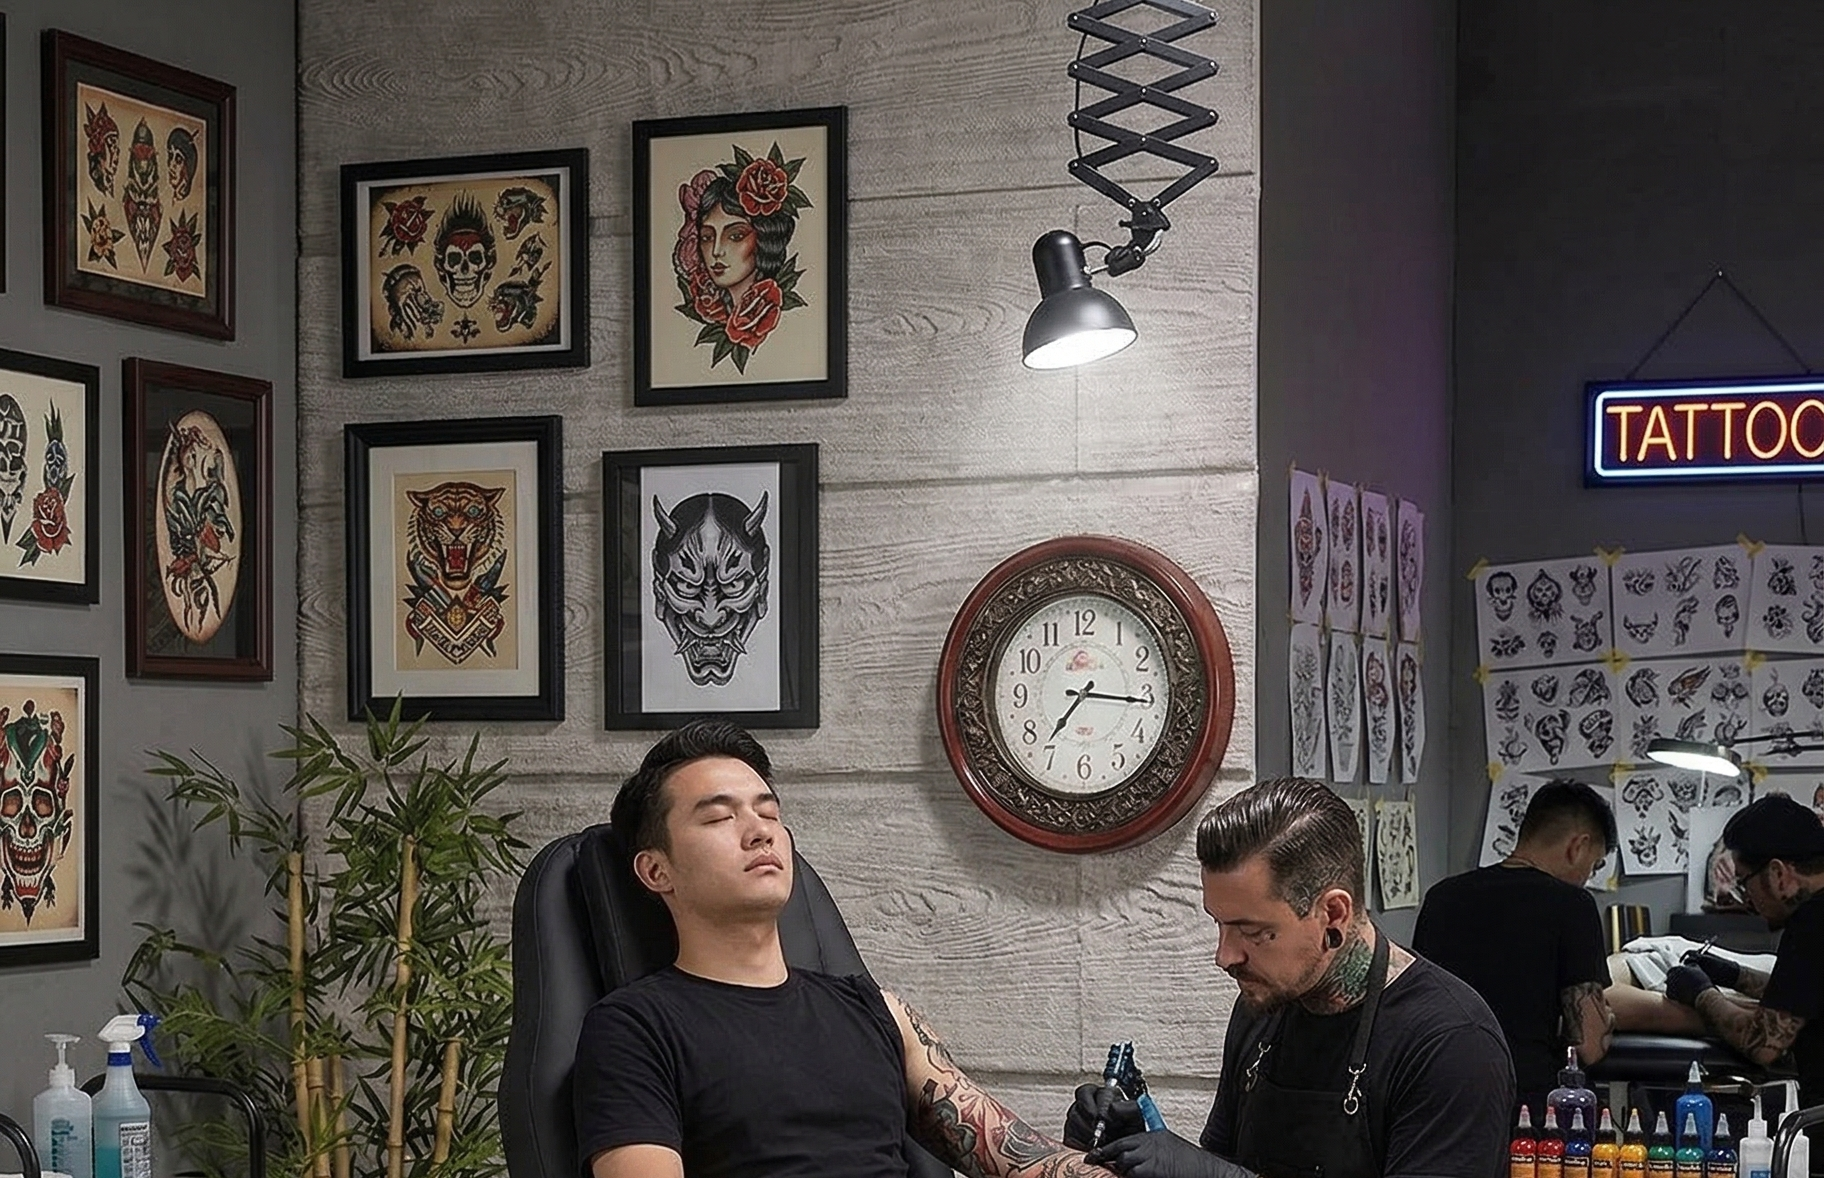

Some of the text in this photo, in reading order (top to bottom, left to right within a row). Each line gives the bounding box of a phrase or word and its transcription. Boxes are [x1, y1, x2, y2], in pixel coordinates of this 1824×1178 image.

[1606, 400, 1824, 462] TATTOO
[1043, 622, 1059, 647] 11
[1074, 609, 1096, 636] 12
[1116, 621, 1123, 646] 1
[1020, 648, 1041, 674] 10
[1135, 646, 1150, 672] 2
[1013, 683, 1028, 709] 9
[1141, 684, 1155, 709] 3
[1022, 719, 1038, 745] 8
[1131, 718, 1144, 743] 4
[1043, 744, 1056, 771] 7
[1077, 754, 1092, 780] 6
[1111, 743, 1126, 771] 5
